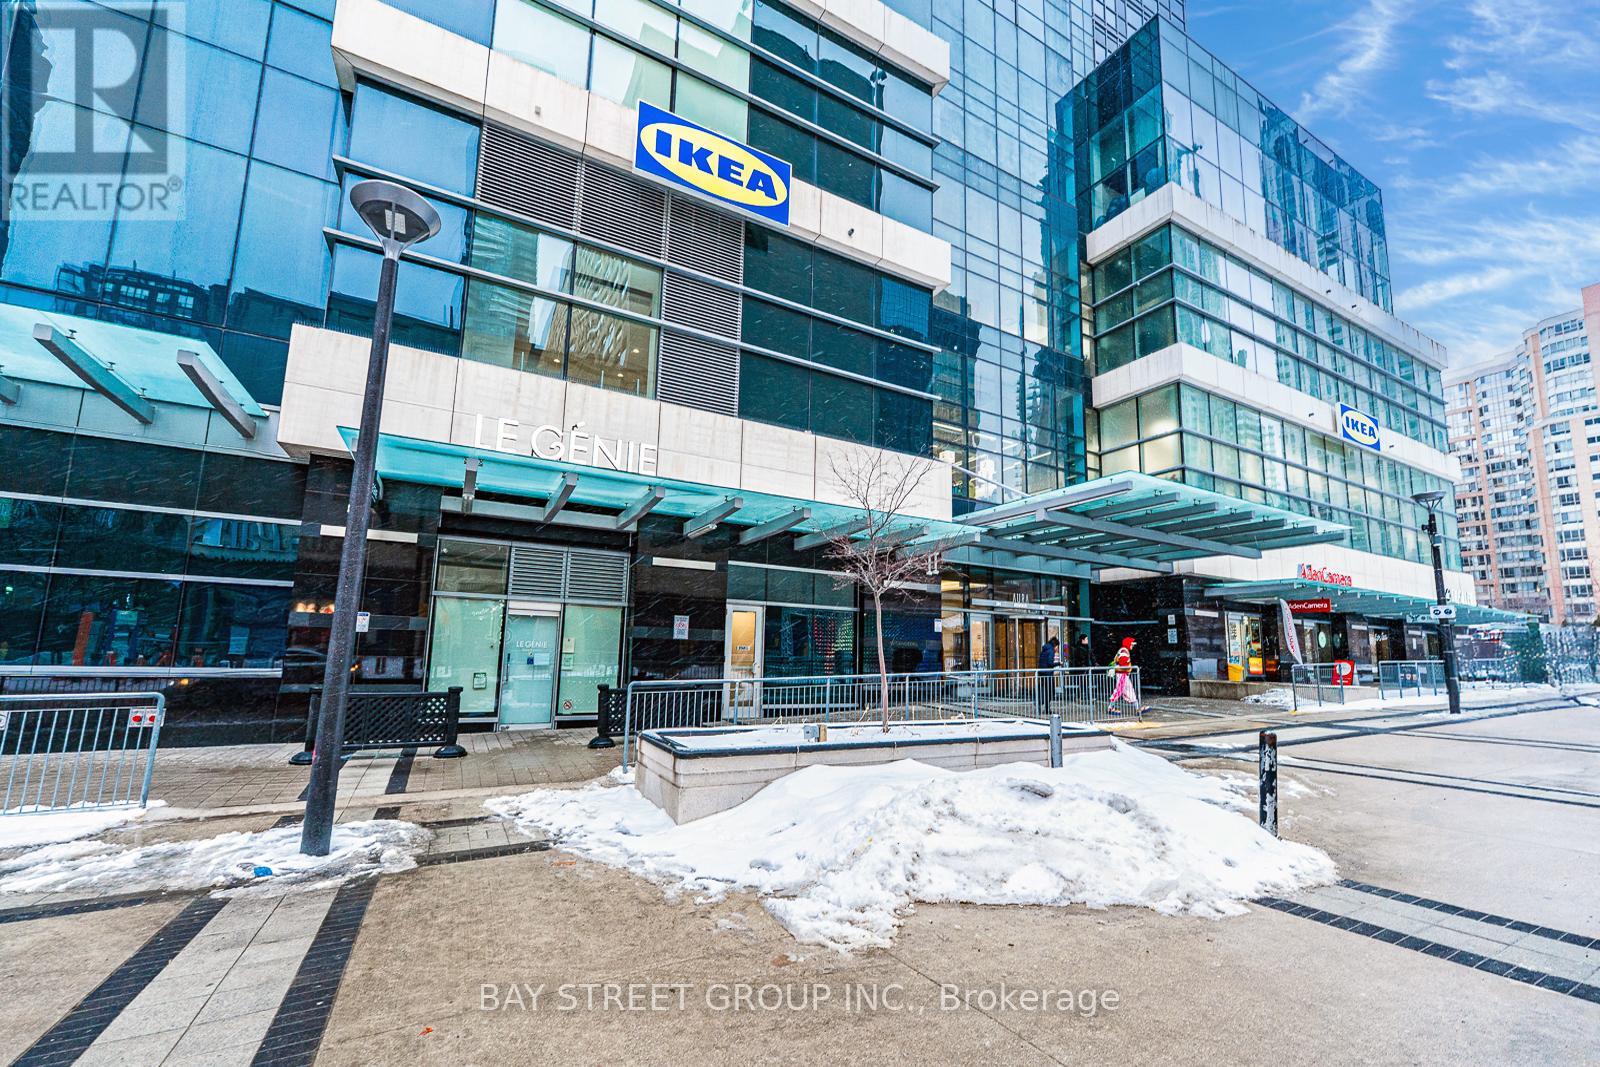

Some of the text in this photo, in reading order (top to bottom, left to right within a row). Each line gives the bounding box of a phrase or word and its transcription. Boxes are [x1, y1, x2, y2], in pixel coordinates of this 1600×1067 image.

[655, 128, 778, 201] IKEA
[474, 413, 658, 476] LE GÉNIE
[1345, 415, 1377, 440] IKEA
[516, 640, 524, 648] LE
